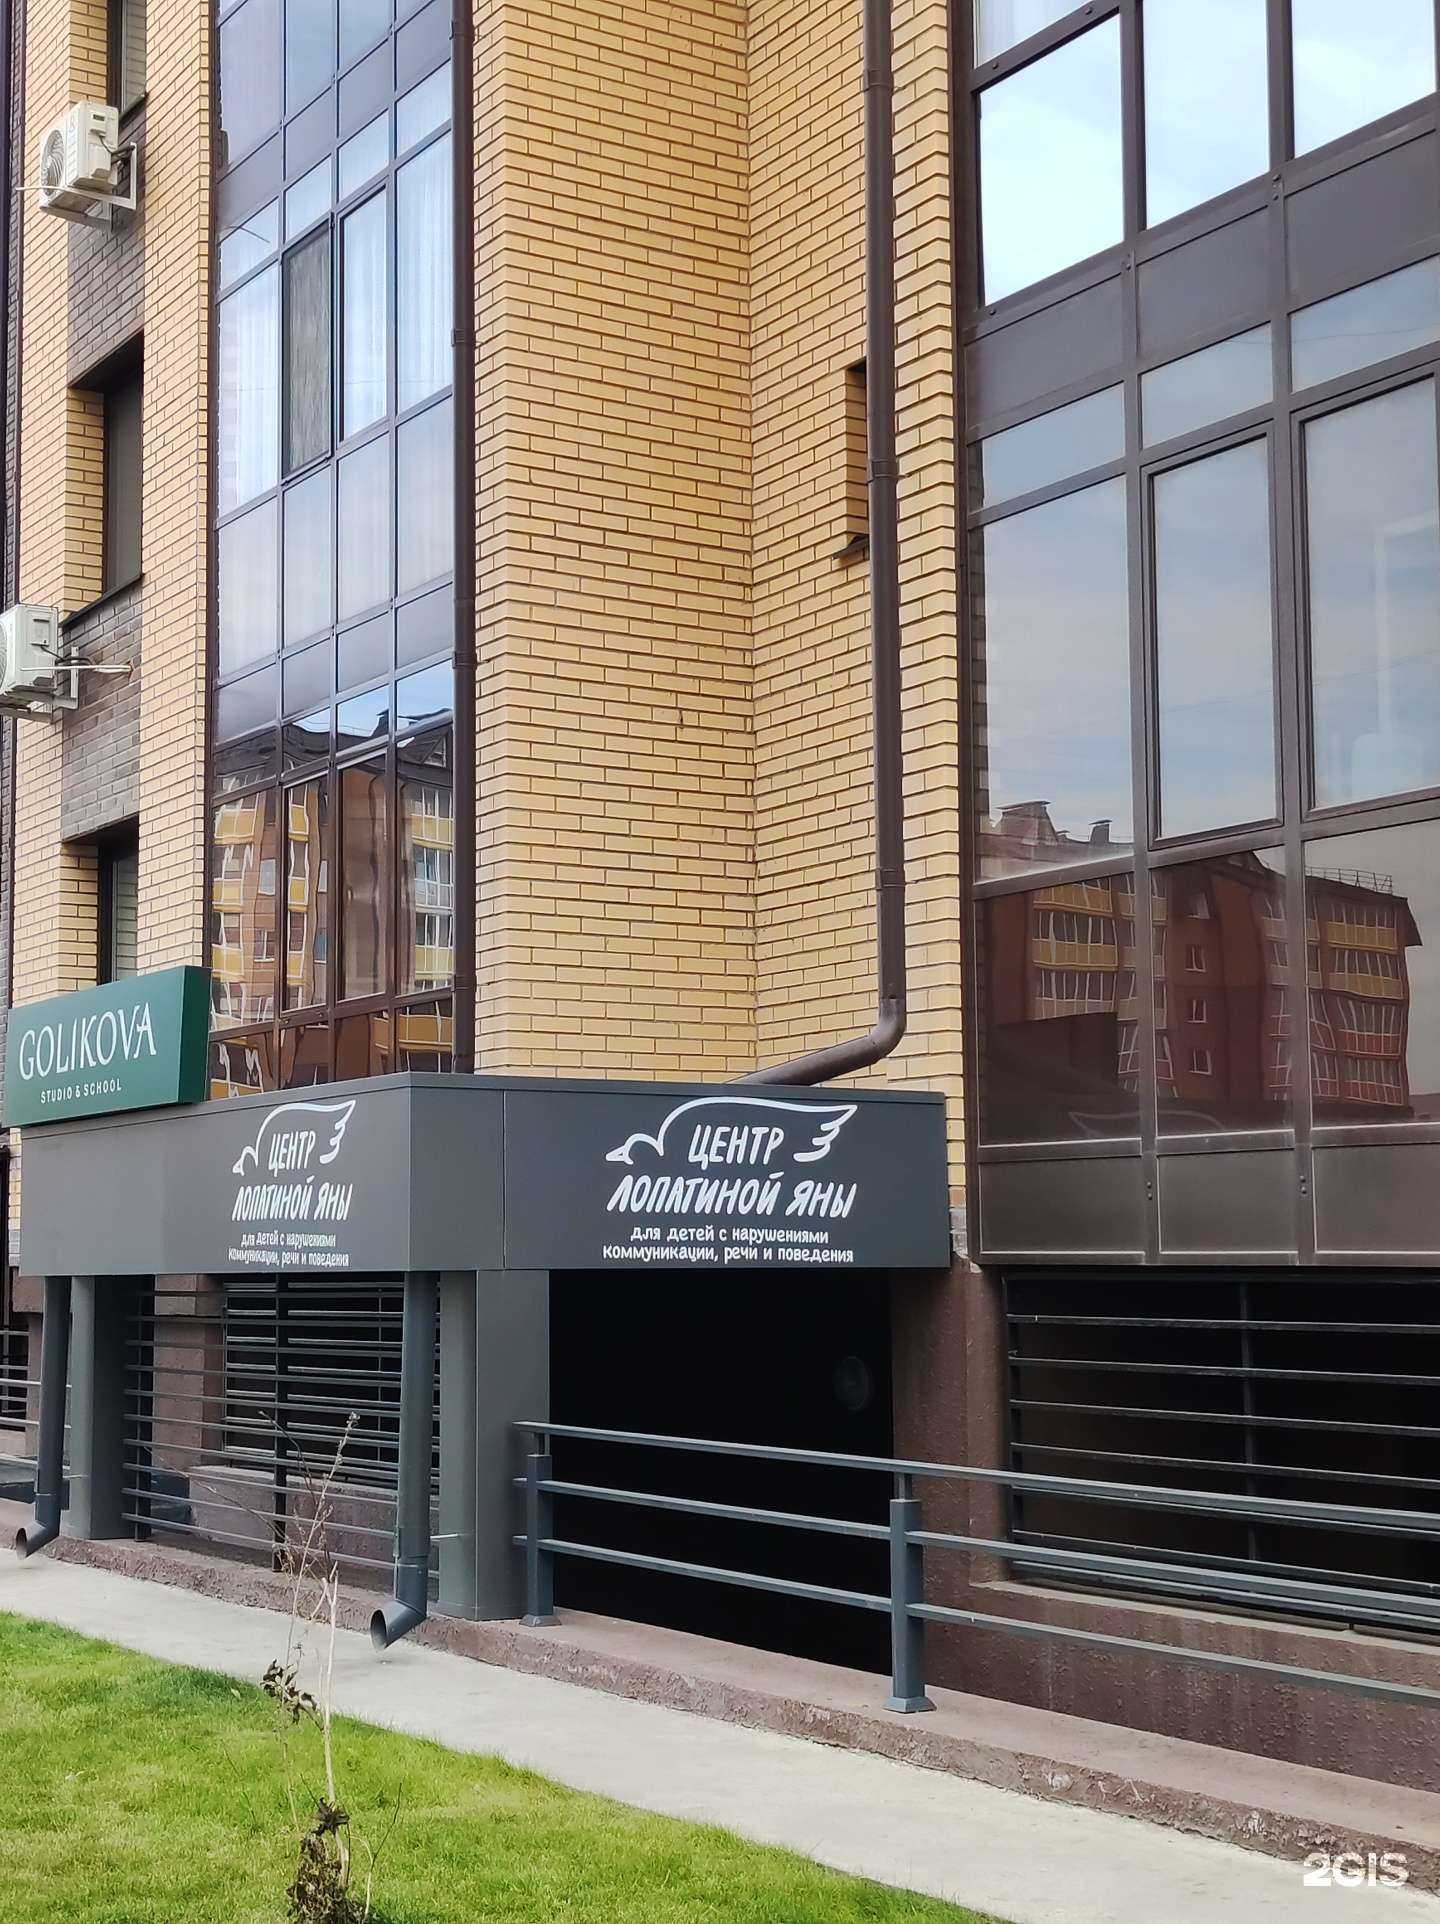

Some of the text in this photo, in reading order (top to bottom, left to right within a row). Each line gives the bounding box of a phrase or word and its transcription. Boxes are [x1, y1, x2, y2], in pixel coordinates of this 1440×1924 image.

[19, 1002, 157, 1080] GOLIKOVA
[40, 1086, 73, 1104] STUDIO
[83, 1078, 122, 1097] SCHOOL
[268, 1130, 316, 1177] ЦЕНТР
[688, 1124, 785, 1170] ЦЕНТР
[232, 1175, 353, 1221] ЛОПАТИНОЙ ЯНЫ
[606, 1171, 857, 1218] ЛОПАТИНОЙ ЯНЫ
[602, 1244, 854, 1264] коммуникации, речи и поведения
[630, 1225, 829, 1245] для детей с нарушениями
[281, 1251, 300, 1268] речи
